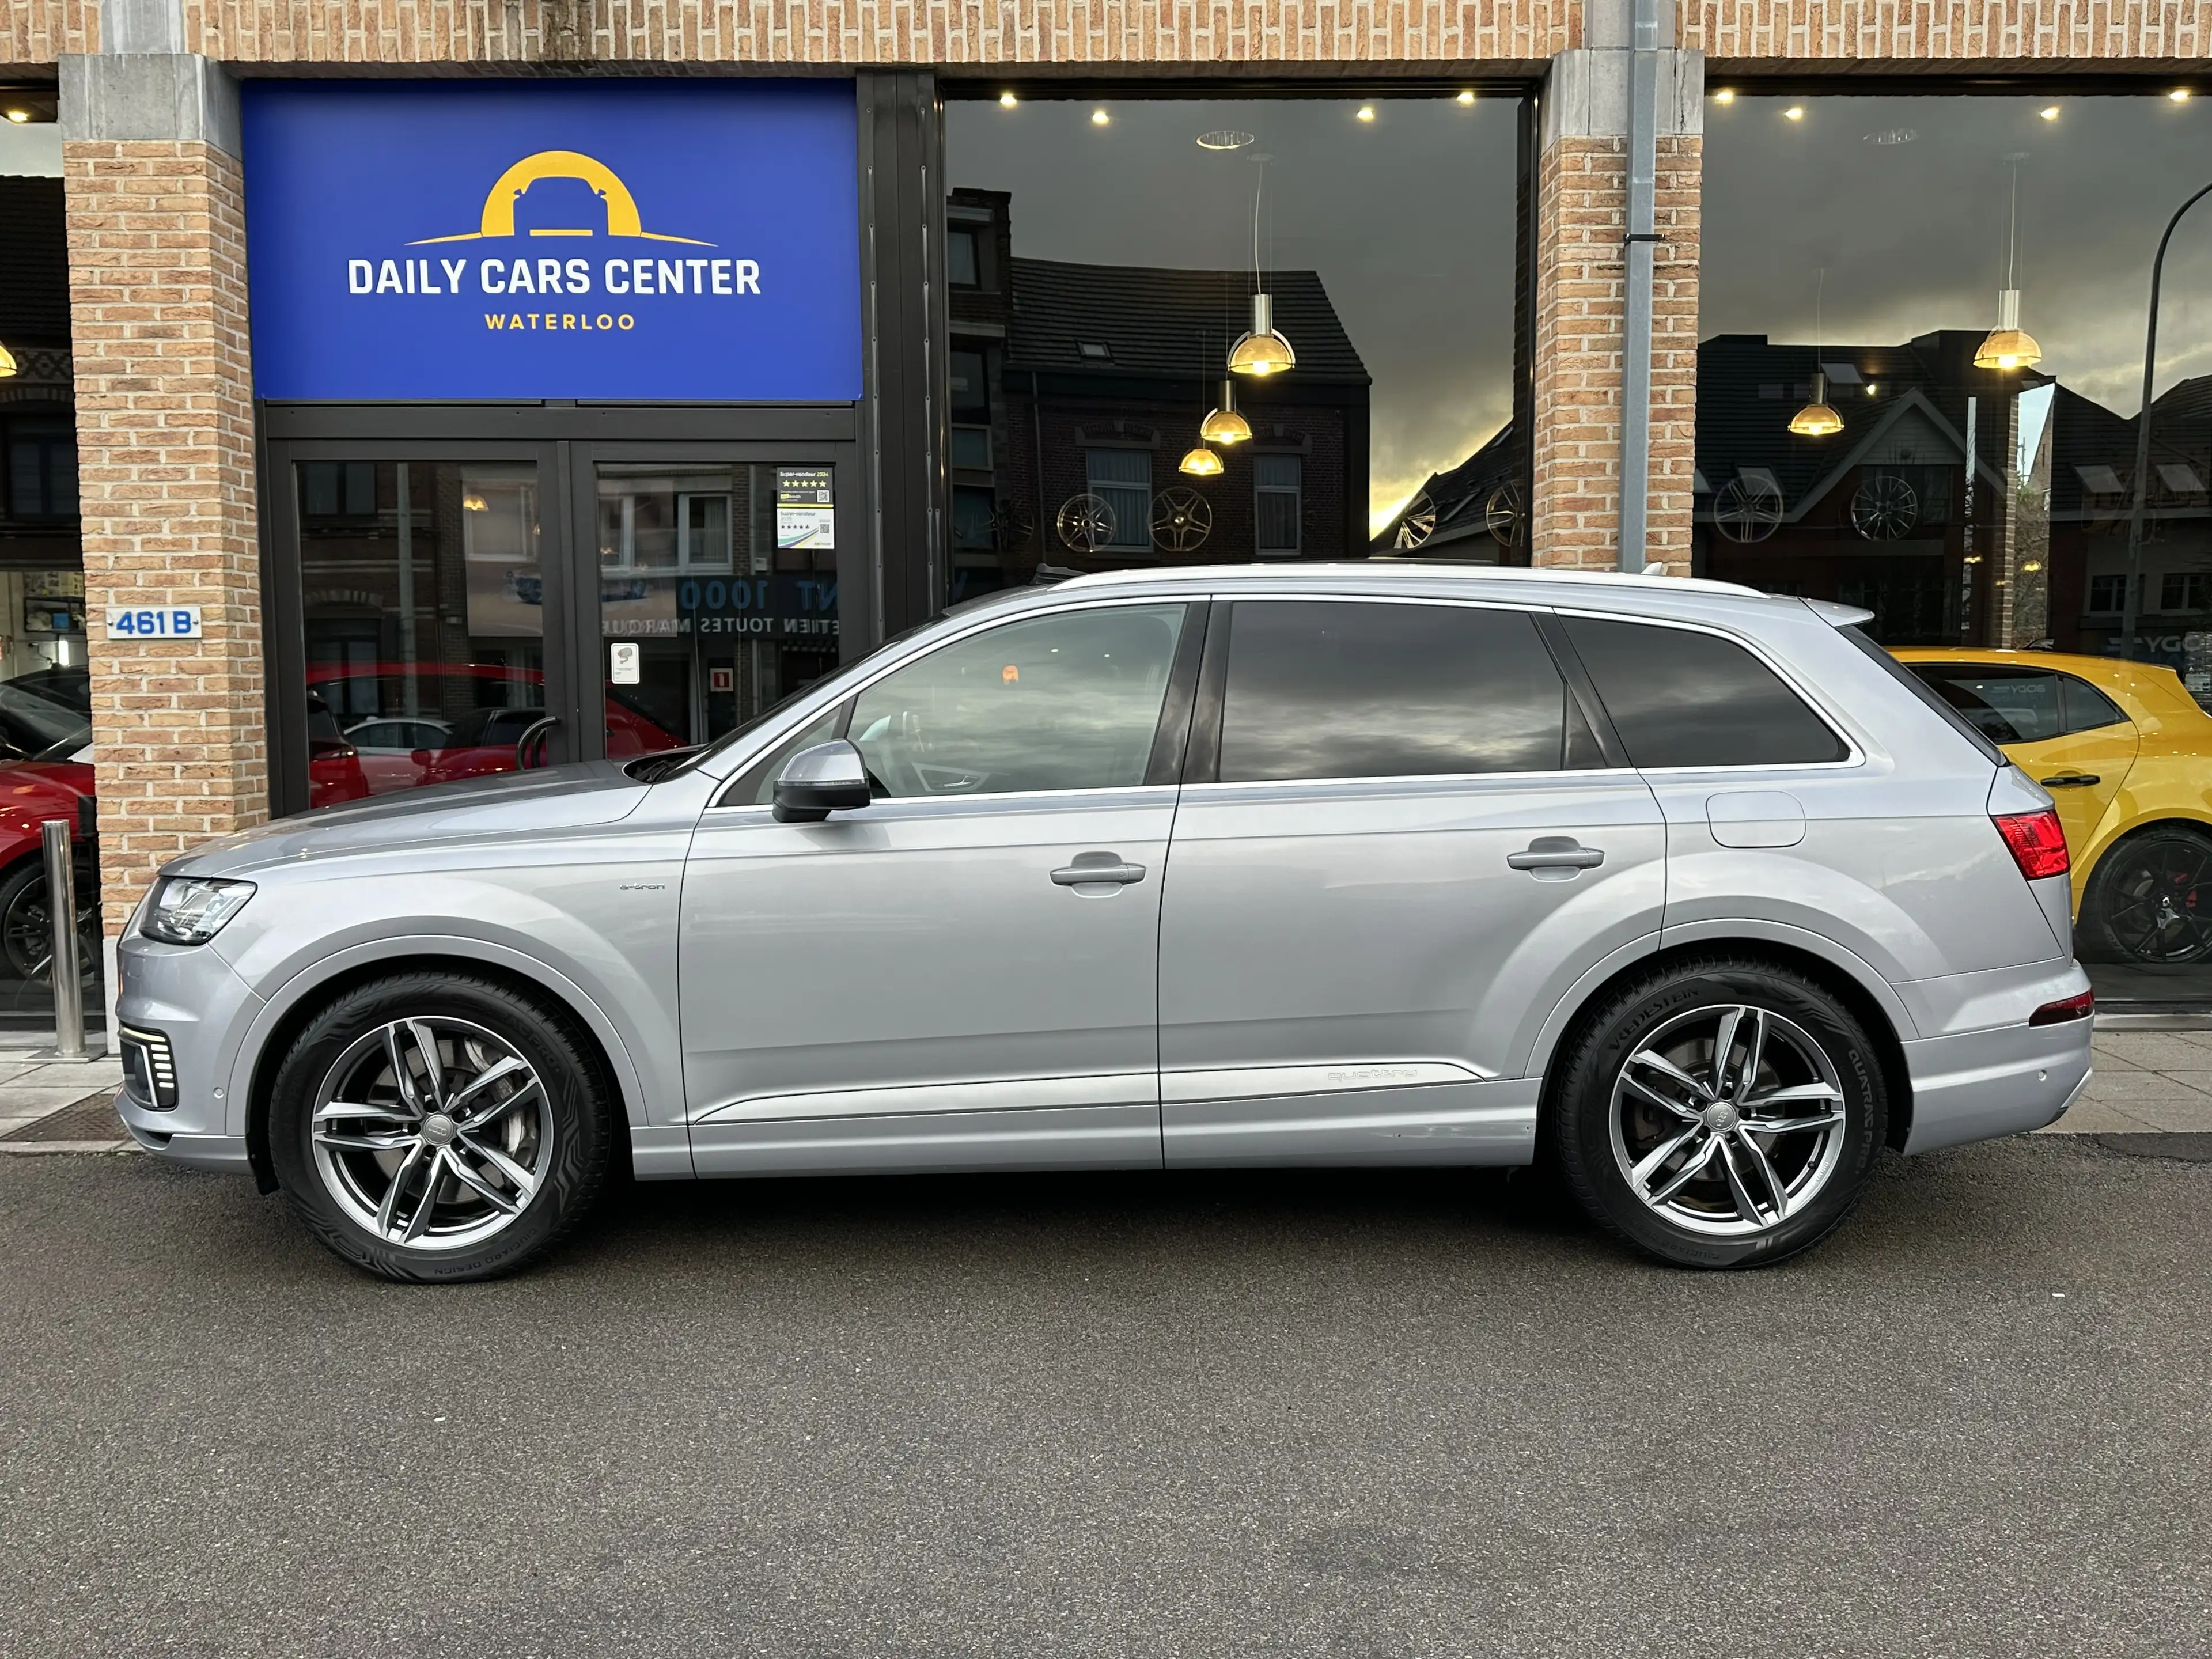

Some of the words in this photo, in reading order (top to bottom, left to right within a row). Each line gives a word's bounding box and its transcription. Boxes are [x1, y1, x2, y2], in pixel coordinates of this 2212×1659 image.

[347, 259, 467, 294] DAILY
[480, 259, 591, 294] CARS
[605, 259, 762, 294] CENTER
[484, 313, 635, 331] WATERLOO
[116, 611, 165, 635] 461
[173, 610, 192, 634] B
[619, 882, 665, 891] e-tron
[1607, 986, 1699, 1050] VREDESTEIN
[1328, 1068, 1418, 1082] quattro
[1847, 1048, 1874, 1128] QUATRAC
[434, 1260, 482, 1275] DESIGN
